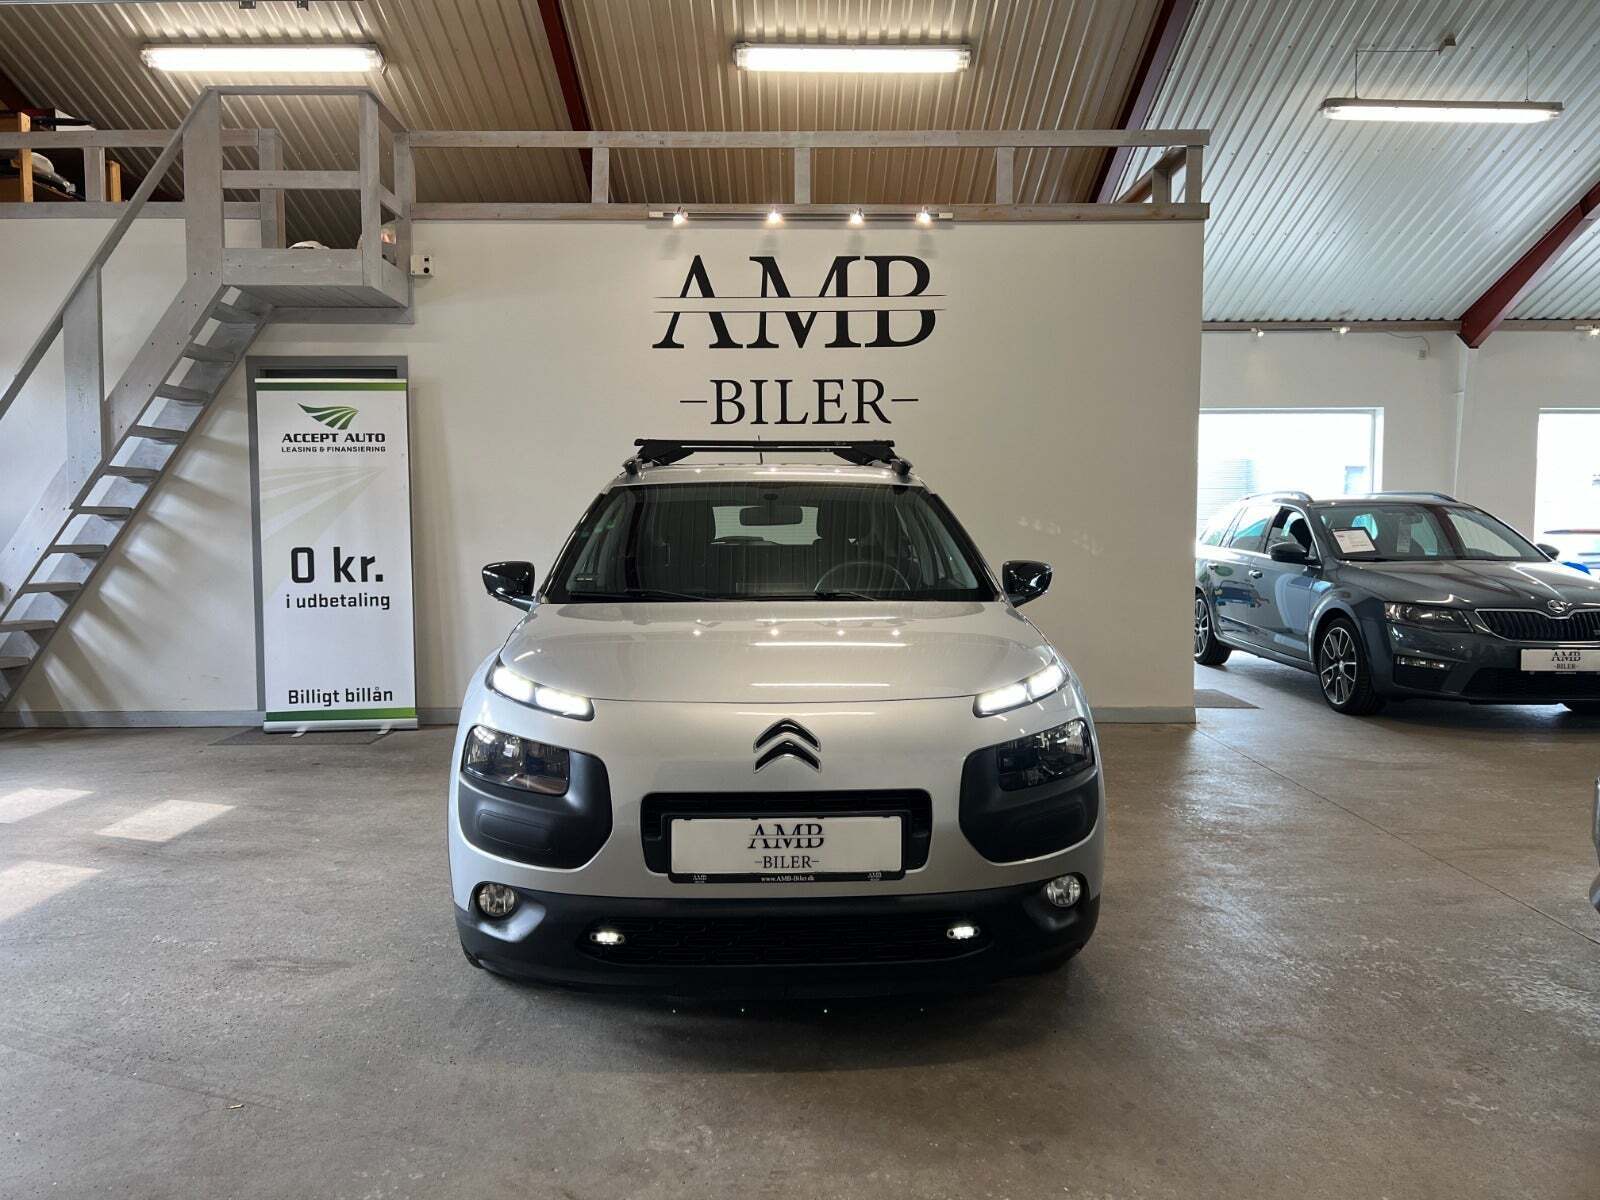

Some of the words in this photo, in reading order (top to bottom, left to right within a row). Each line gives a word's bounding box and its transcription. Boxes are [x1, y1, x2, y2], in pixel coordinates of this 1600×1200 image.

[652, 255, 946, 348] AMB
[282, 433, 339, 443] ACCEPT
[344, 433, 386, 443] AUTO
[291, 547, 315, 583] 0
[333, 547, 383, 582] kr.
[286, 594, 290, 608] i
[296, 592, 390, 610] udbetaling
[288, 689, 340, 707] Billigt
[345, 687, 393, 703] billån
[747, 823, 825, 849] AMB
